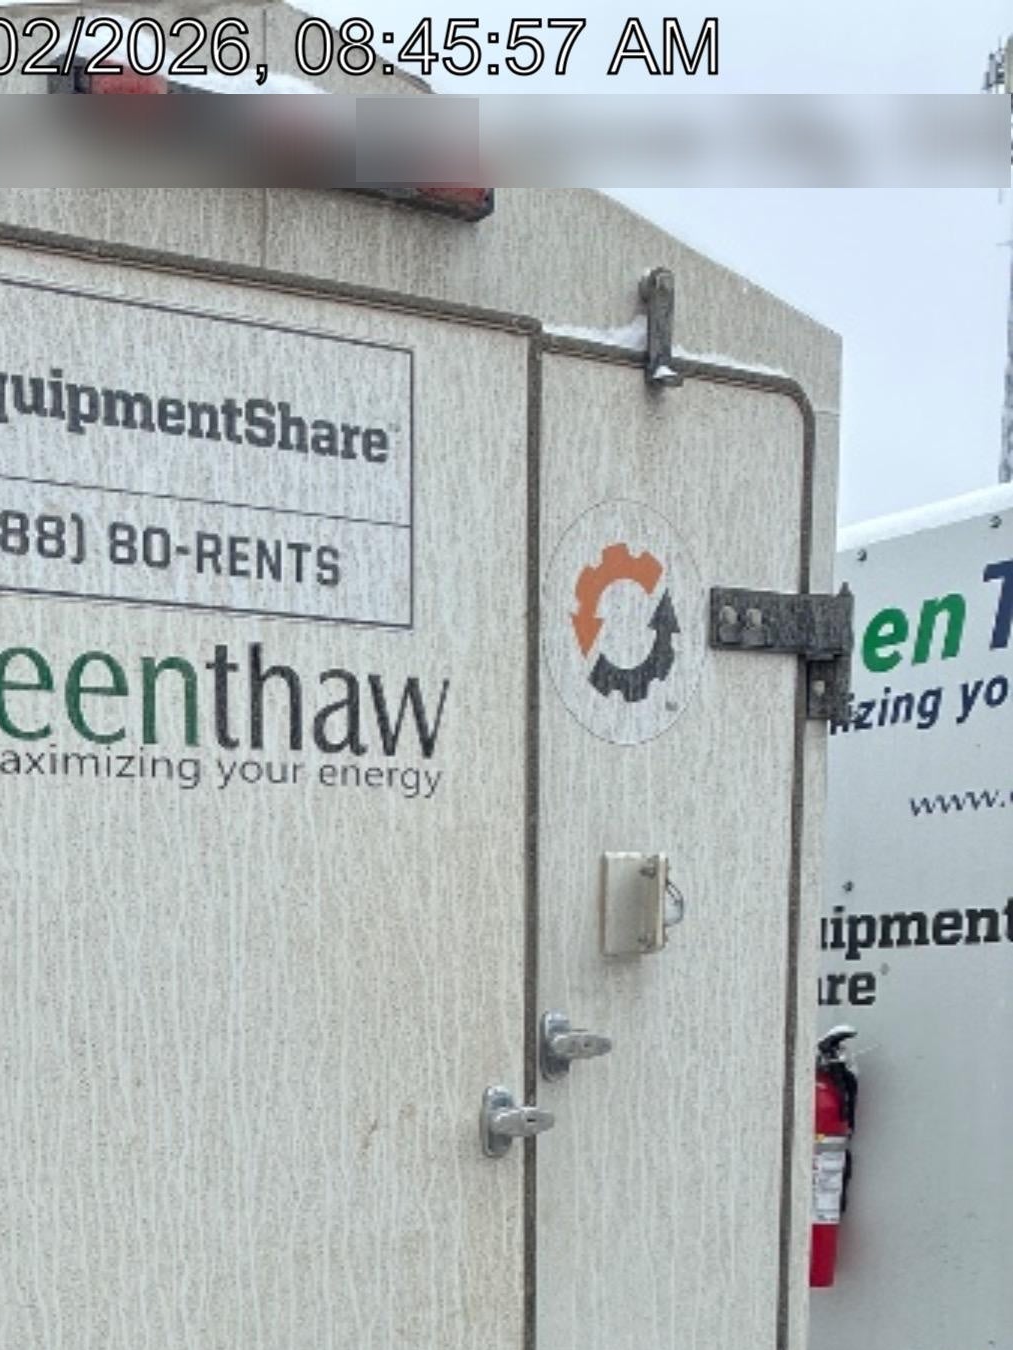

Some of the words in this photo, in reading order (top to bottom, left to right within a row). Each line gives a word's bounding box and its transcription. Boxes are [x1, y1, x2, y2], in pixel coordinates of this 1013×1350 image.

[108, 521, 341, 587] 80-RENTS
[860, 592, 967, 674] en
[217, 756, 305, 791] your
[318, 761, 443, 799] energy
[818, 970, 877, 1007] re
